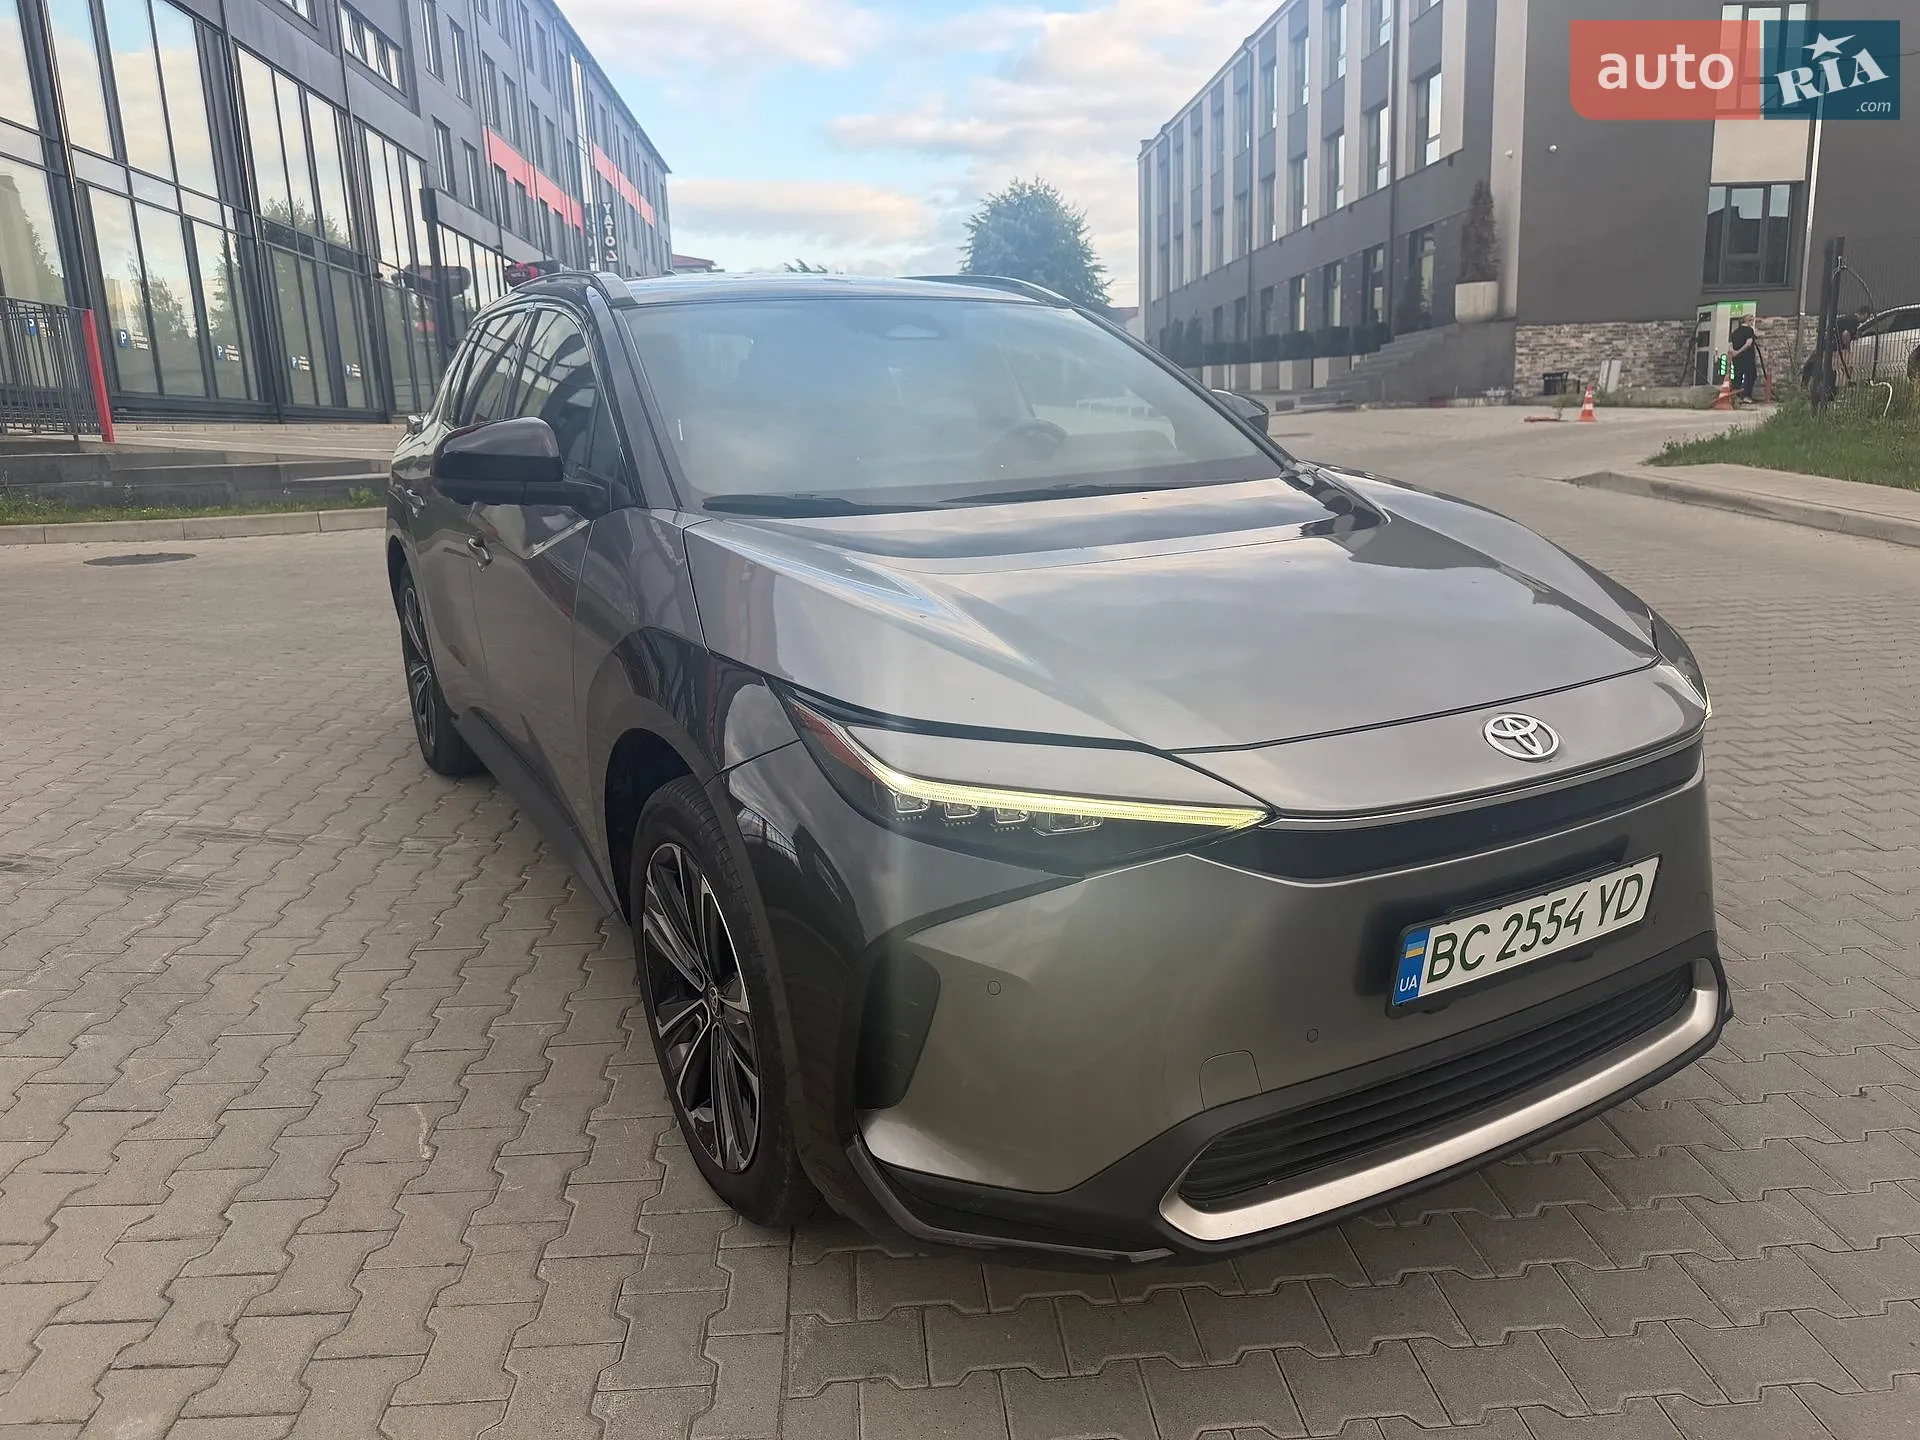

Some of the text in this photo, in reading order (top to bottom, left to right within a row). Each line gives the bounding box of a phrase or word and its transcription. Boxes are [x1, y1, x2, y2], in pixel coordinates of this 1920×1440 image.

[603, 203, 616, 247] YATO
[1426, 873, 1643, 983] BC 2554 YD
[1399, 974, 1417, 992] UA
